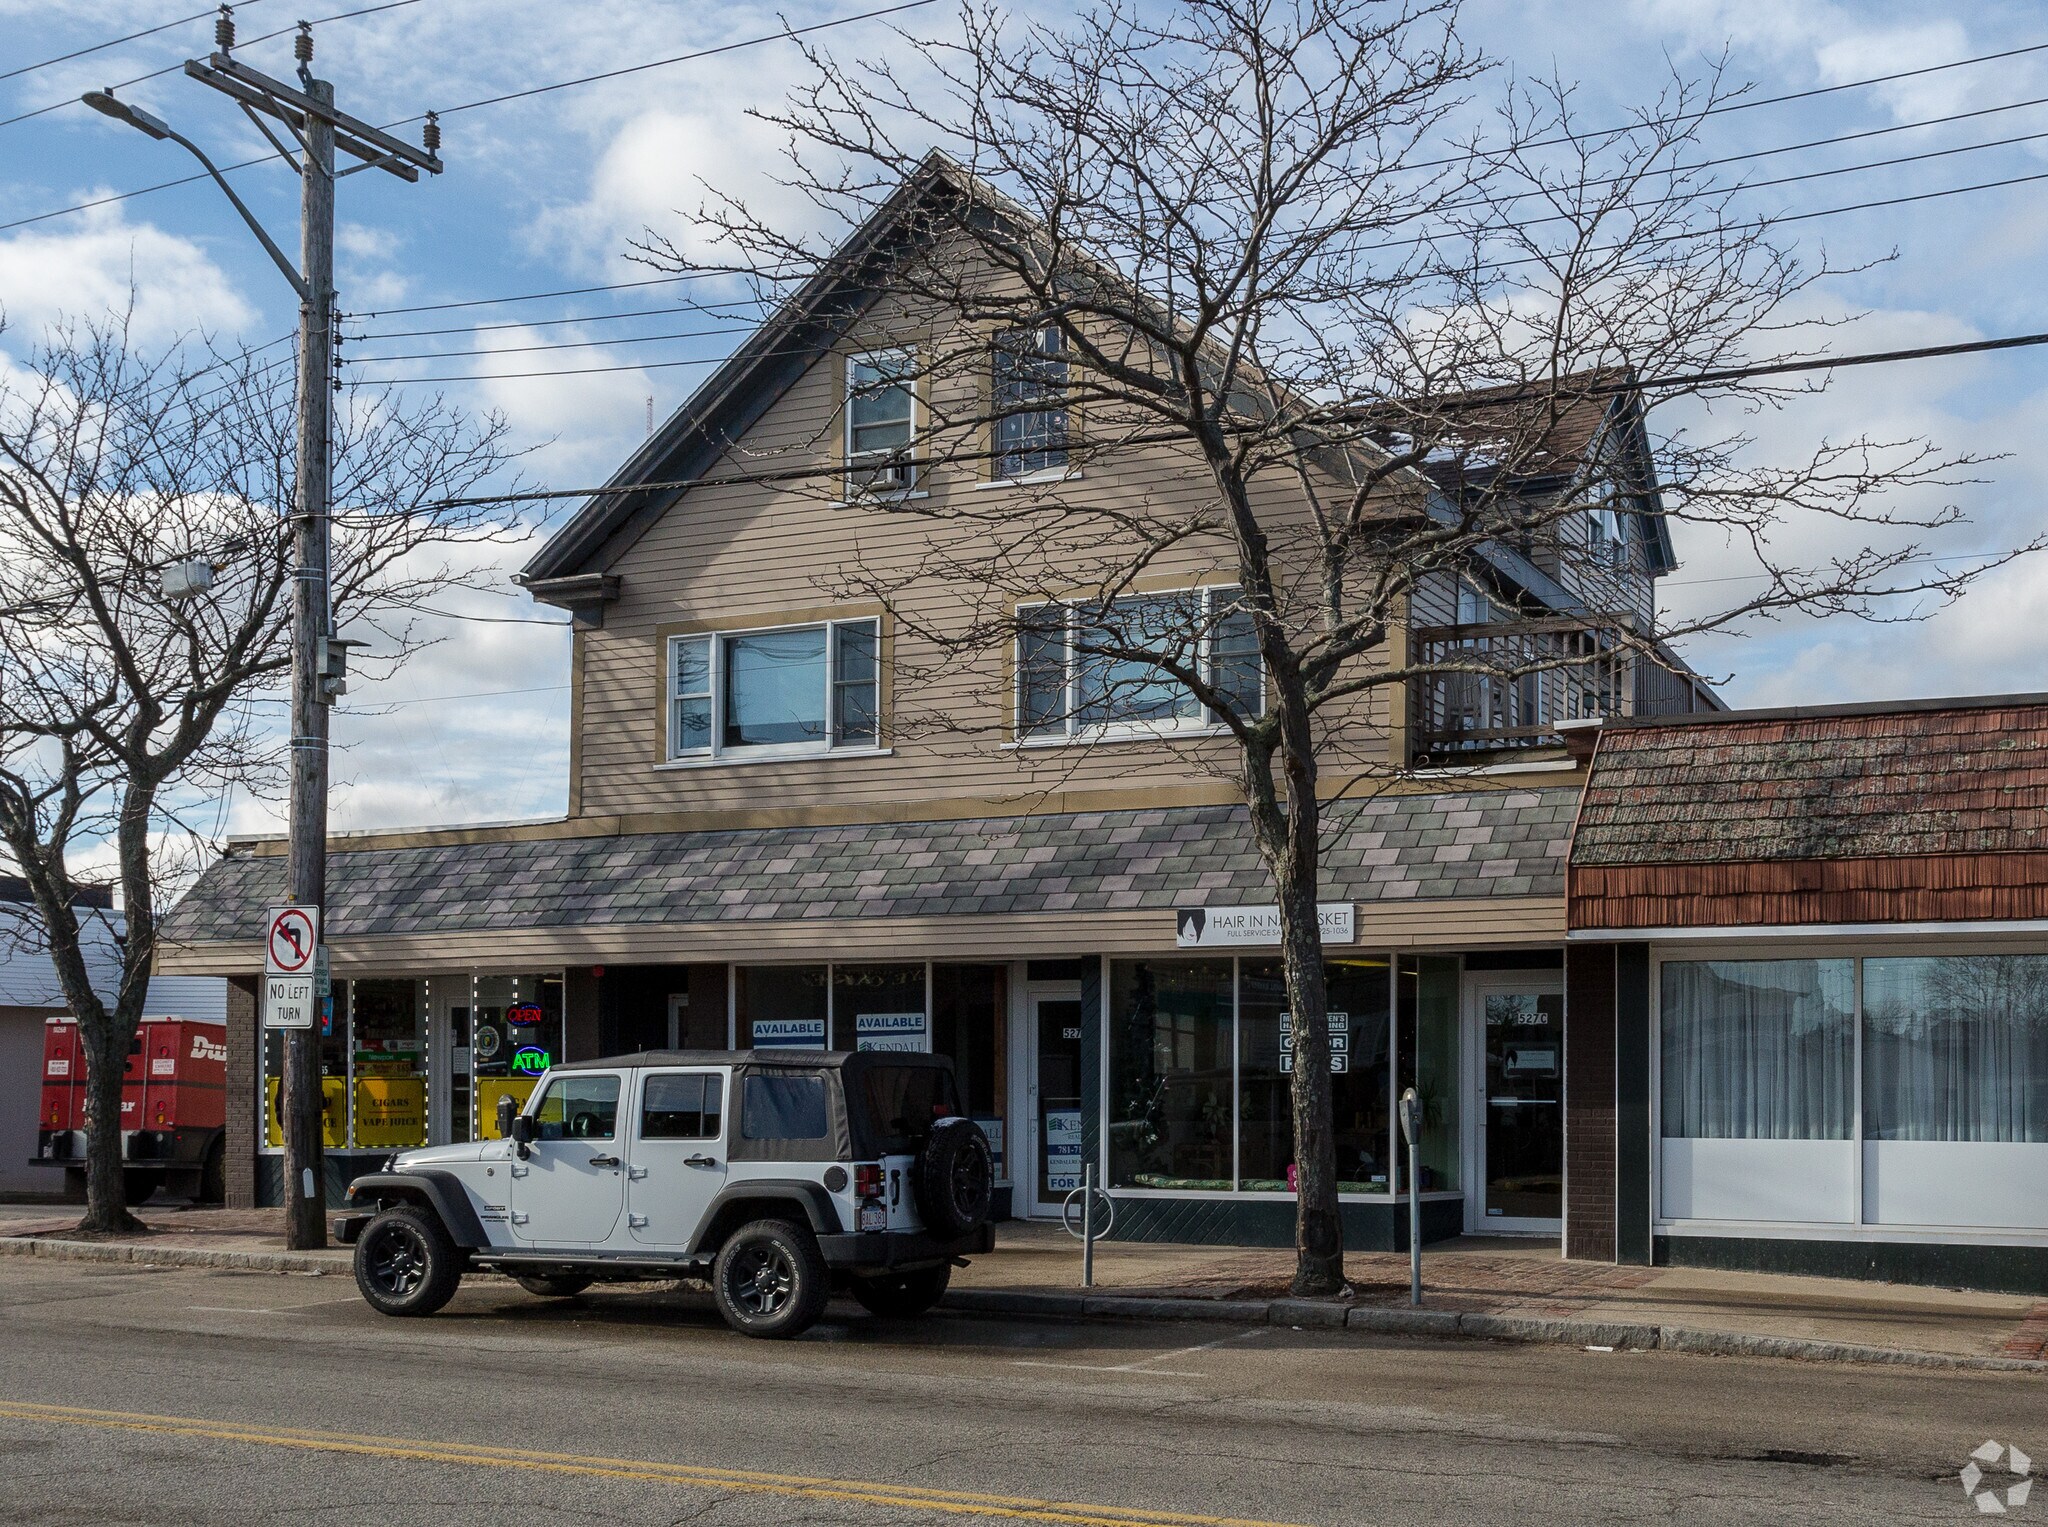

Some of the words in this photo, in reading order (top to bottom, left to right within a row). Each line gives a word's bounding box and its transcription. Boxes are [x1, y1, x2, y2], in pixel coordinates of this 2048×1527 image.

[1213, 916, 1244, 928] HAIR
[1250, 915, 1263, 927] IN
[1243, 929, 1271, 937] SERVICE
[270, 984, 284, 999] NO
[288, 986, 309, 999] LEFT
[278, 1007, 300, 1020] TURN
[507, 1009, 542, 1021] OPEN
[1519, 1014, 1547, 1024] 527C
[858, 1017, 922, 1028] AVAILABLE
[755, 1023, 822, 1034] AVAILABLE
[870, 1042, 926, 1051] KENDALL
[512, 1052, 550, 1070] ATM
[372, 1098, 409, 1107] CIGARS
[363, 1118, 387, 1127] VAPE
[389, 1117, 418, 1127] JUICE
[1051, 1178, 1075, 1188] FOR
